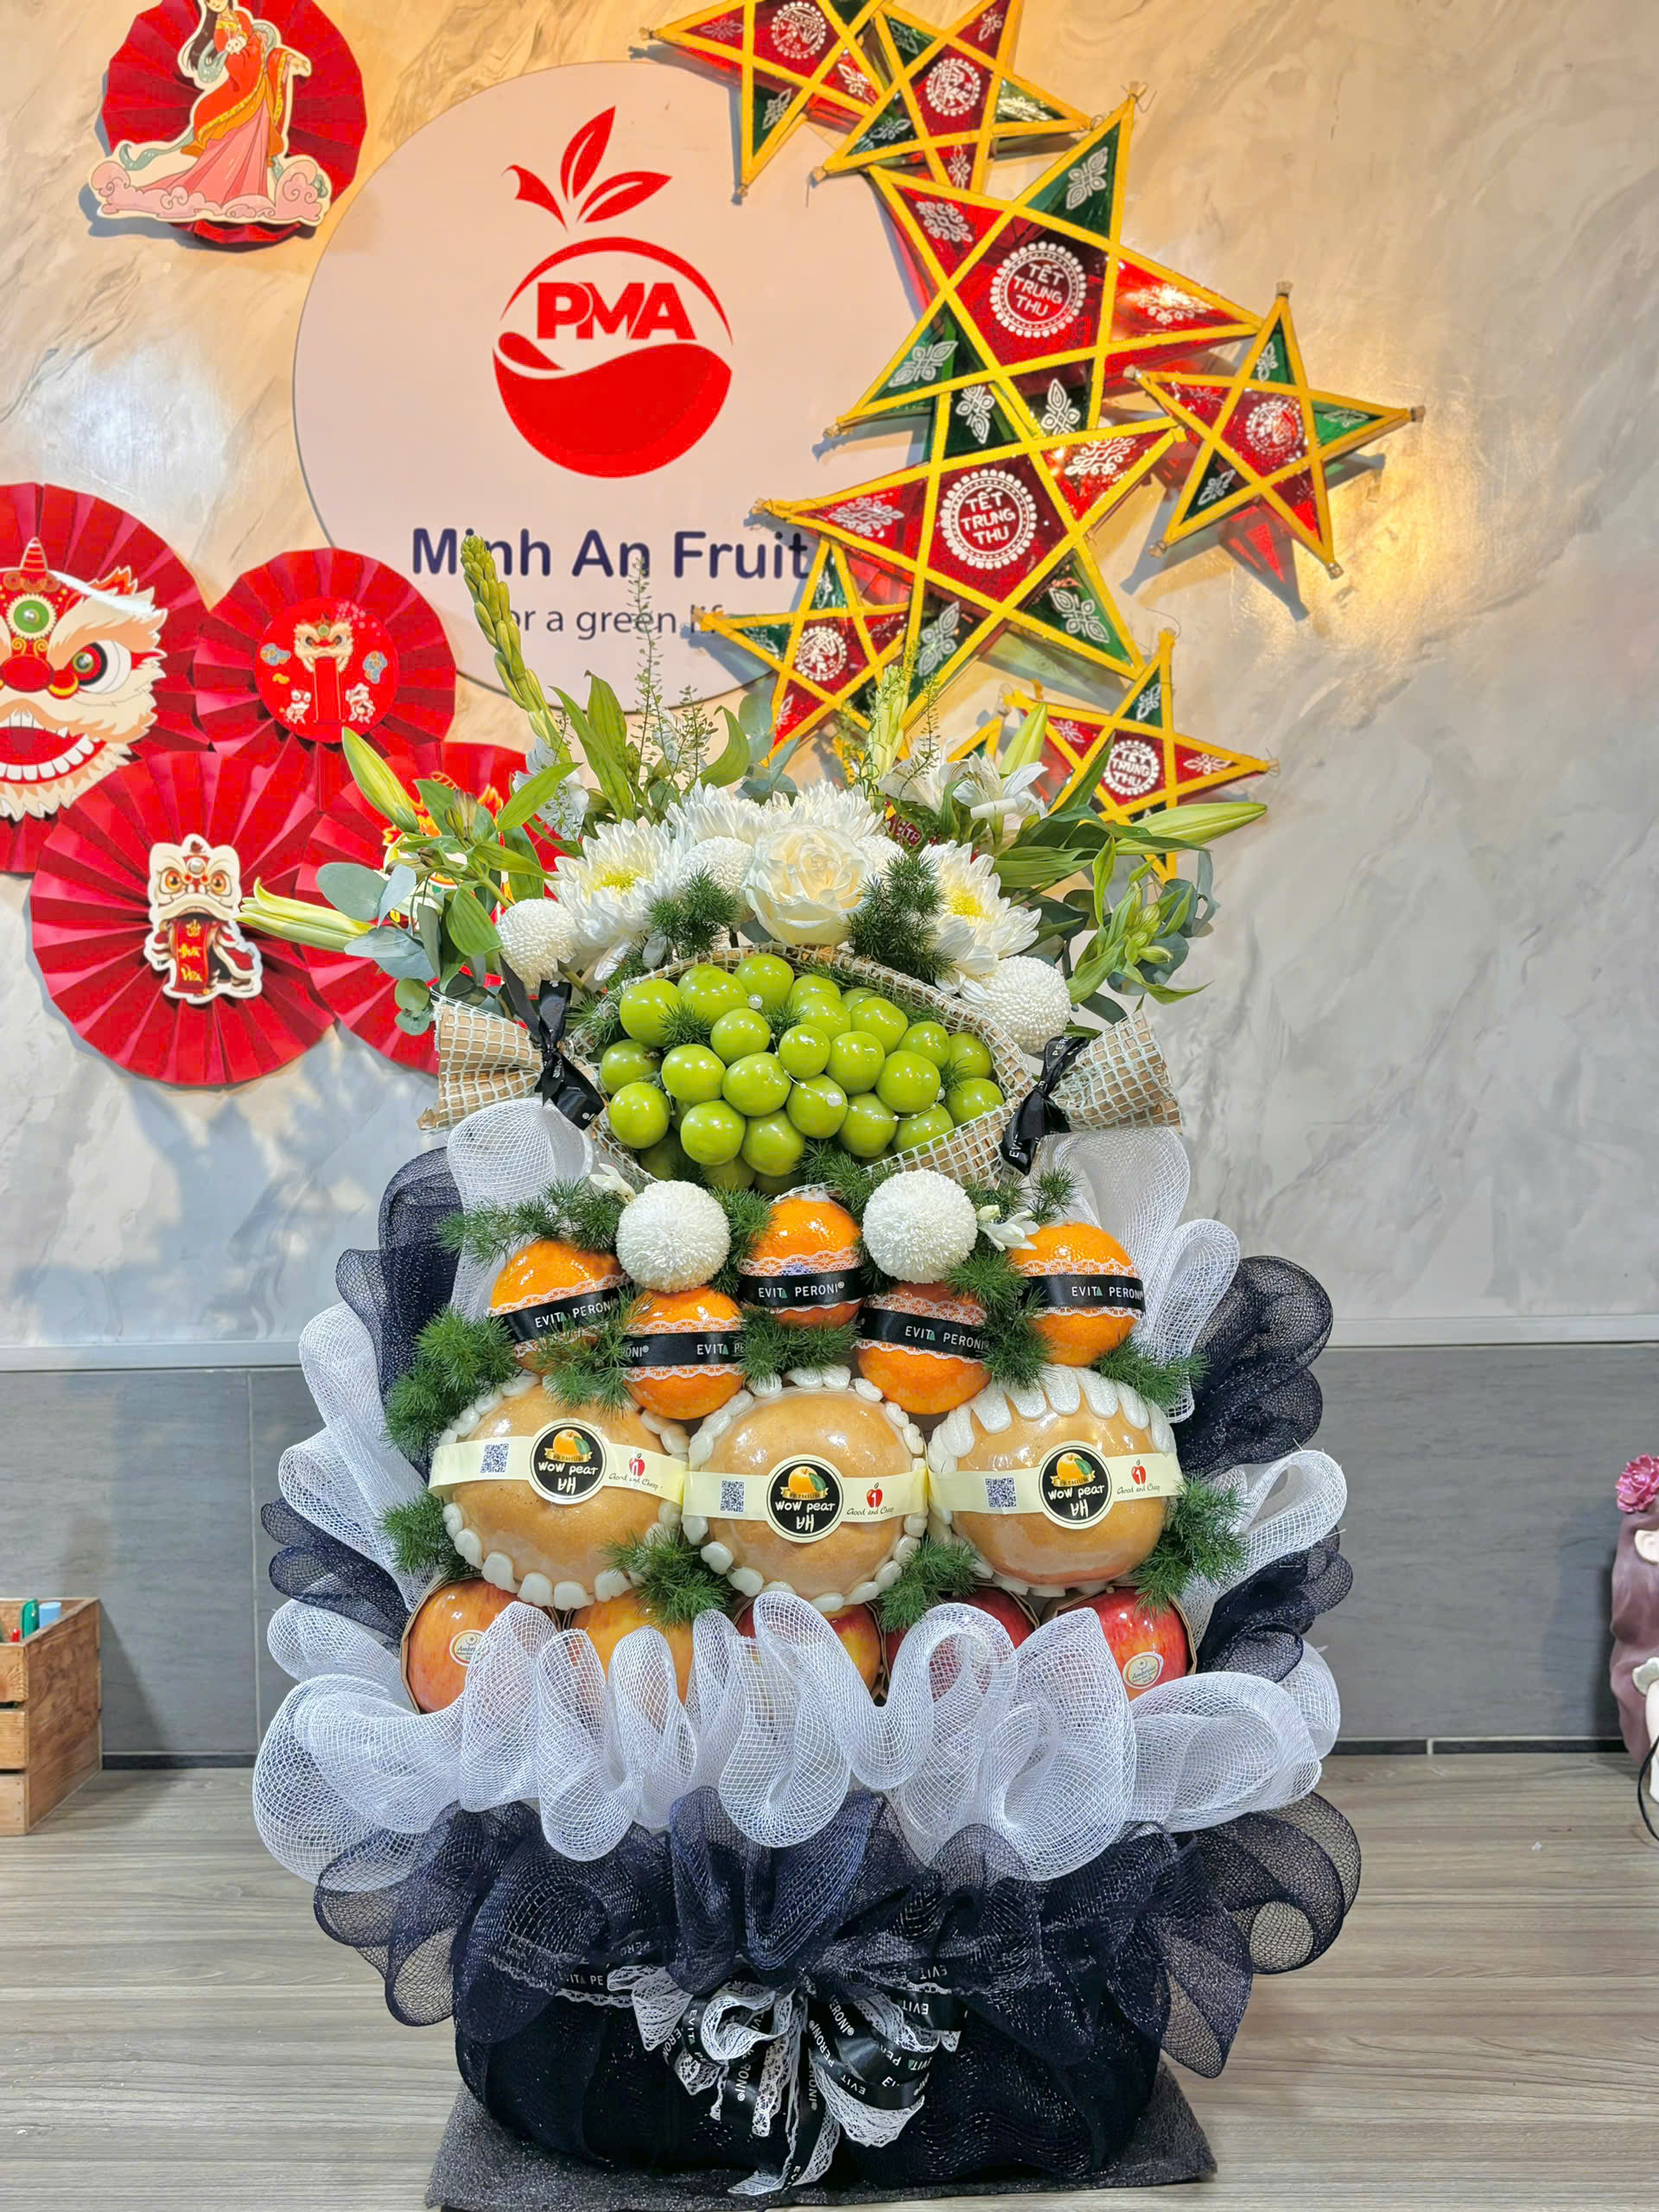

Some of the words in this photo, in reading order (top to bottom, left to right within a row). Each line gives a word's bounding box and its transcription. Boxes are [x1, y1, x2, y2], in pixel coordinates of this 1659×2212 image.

[1028, 263, 1065, 286] TẾT
[1014, 276, 1062, 304] TRUNG
[537, 282, 697, 340] PMA
[1016, 294, 1049, 316] THU
[965, 487, 1003, 512] TẾT
[961, 508, 1016, 531] TRUNG
[973, 526, 1009, 545] THU
[412, 528, 550, 576] Mnh
[571, 529, 650, 578] An
[674, 531, 810, 579] Fruit
[546, 610, 564, 632] a
[576, 610, 676, 640] green
[1112, 759, 1150, 777] TRUNG
[1113, 771, 1141, 788] THU
[569, 1465, 599, 1476] pear
[1077, 1484, 1105, 1499] pear
[806, 1503, 836, 1513] pear
